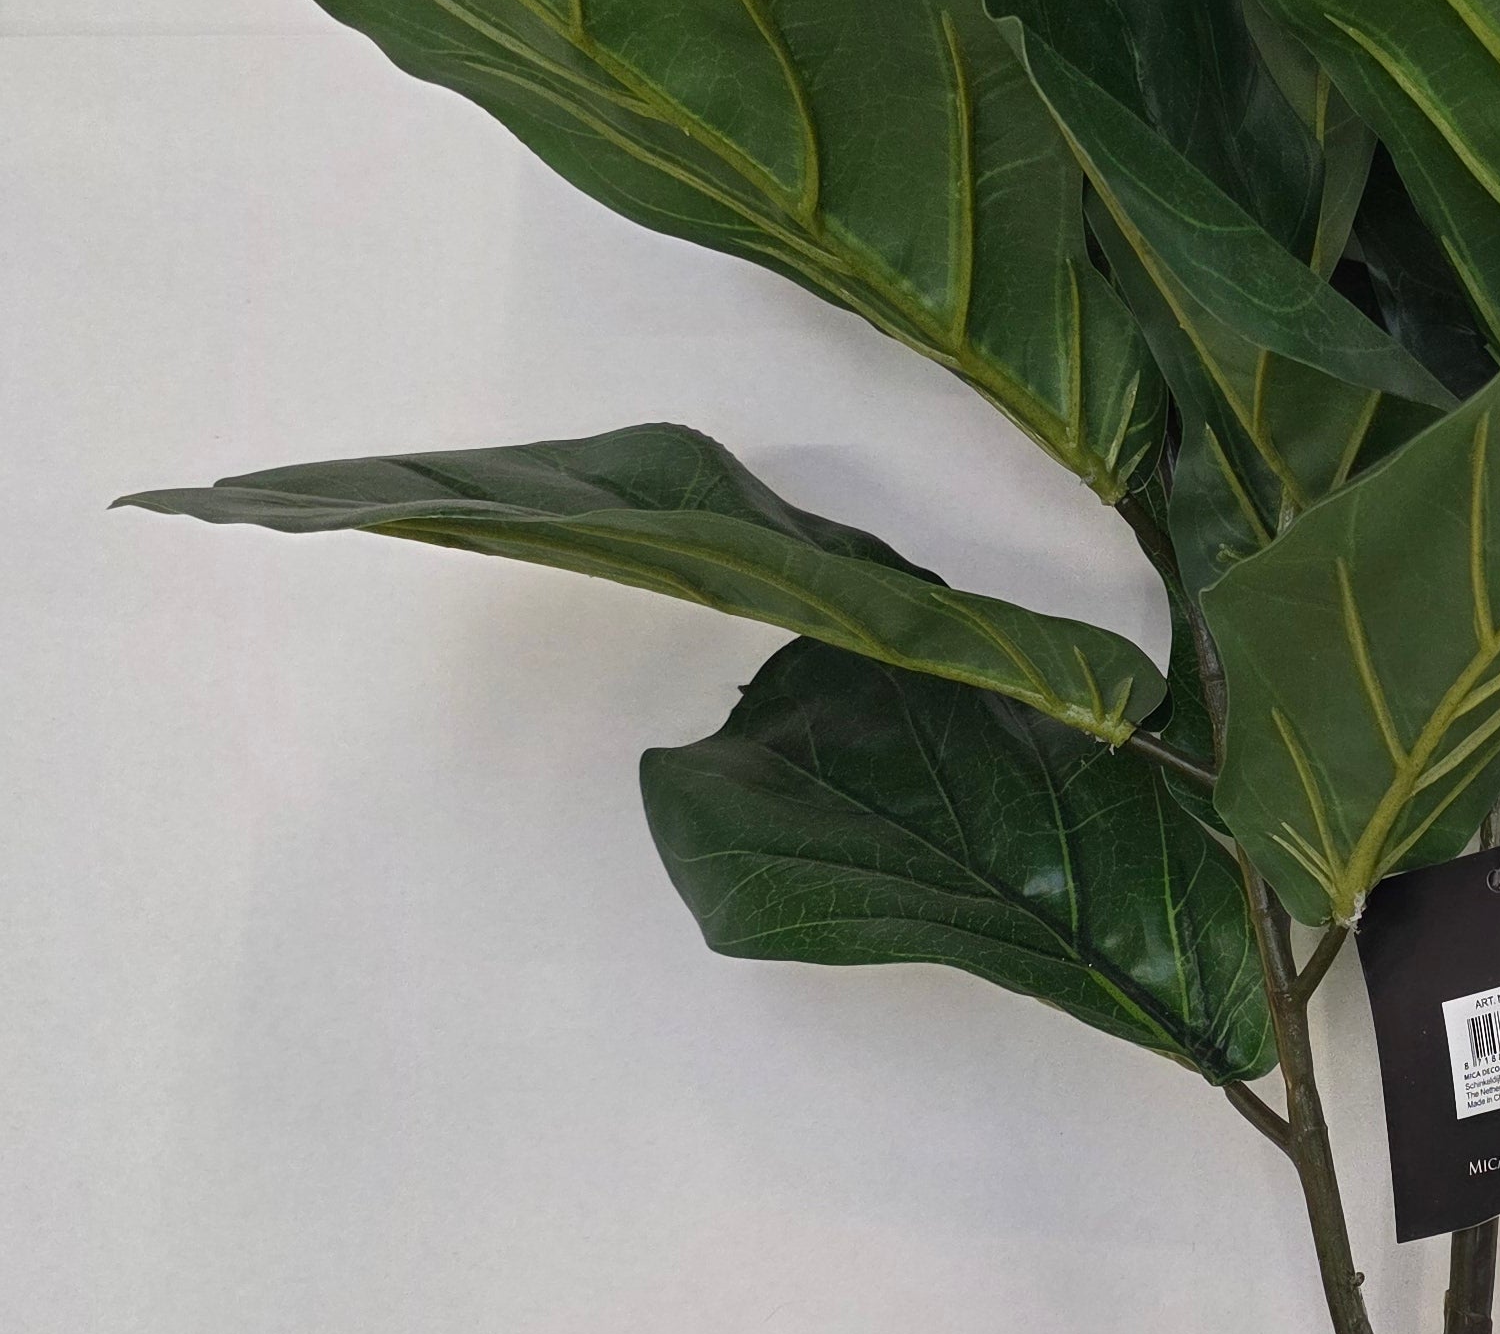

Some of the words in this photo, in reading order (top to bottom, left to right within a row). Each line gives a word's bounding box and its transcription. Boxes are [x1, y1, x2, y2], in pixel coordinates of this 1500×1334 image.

[1475, 996, 1496, 1009] ART.
[1464, 1070, 1480, 1080] MICA
[1466, 1090, 1479, 1100] The
[1467, 1098, 1485, 1108] Made
